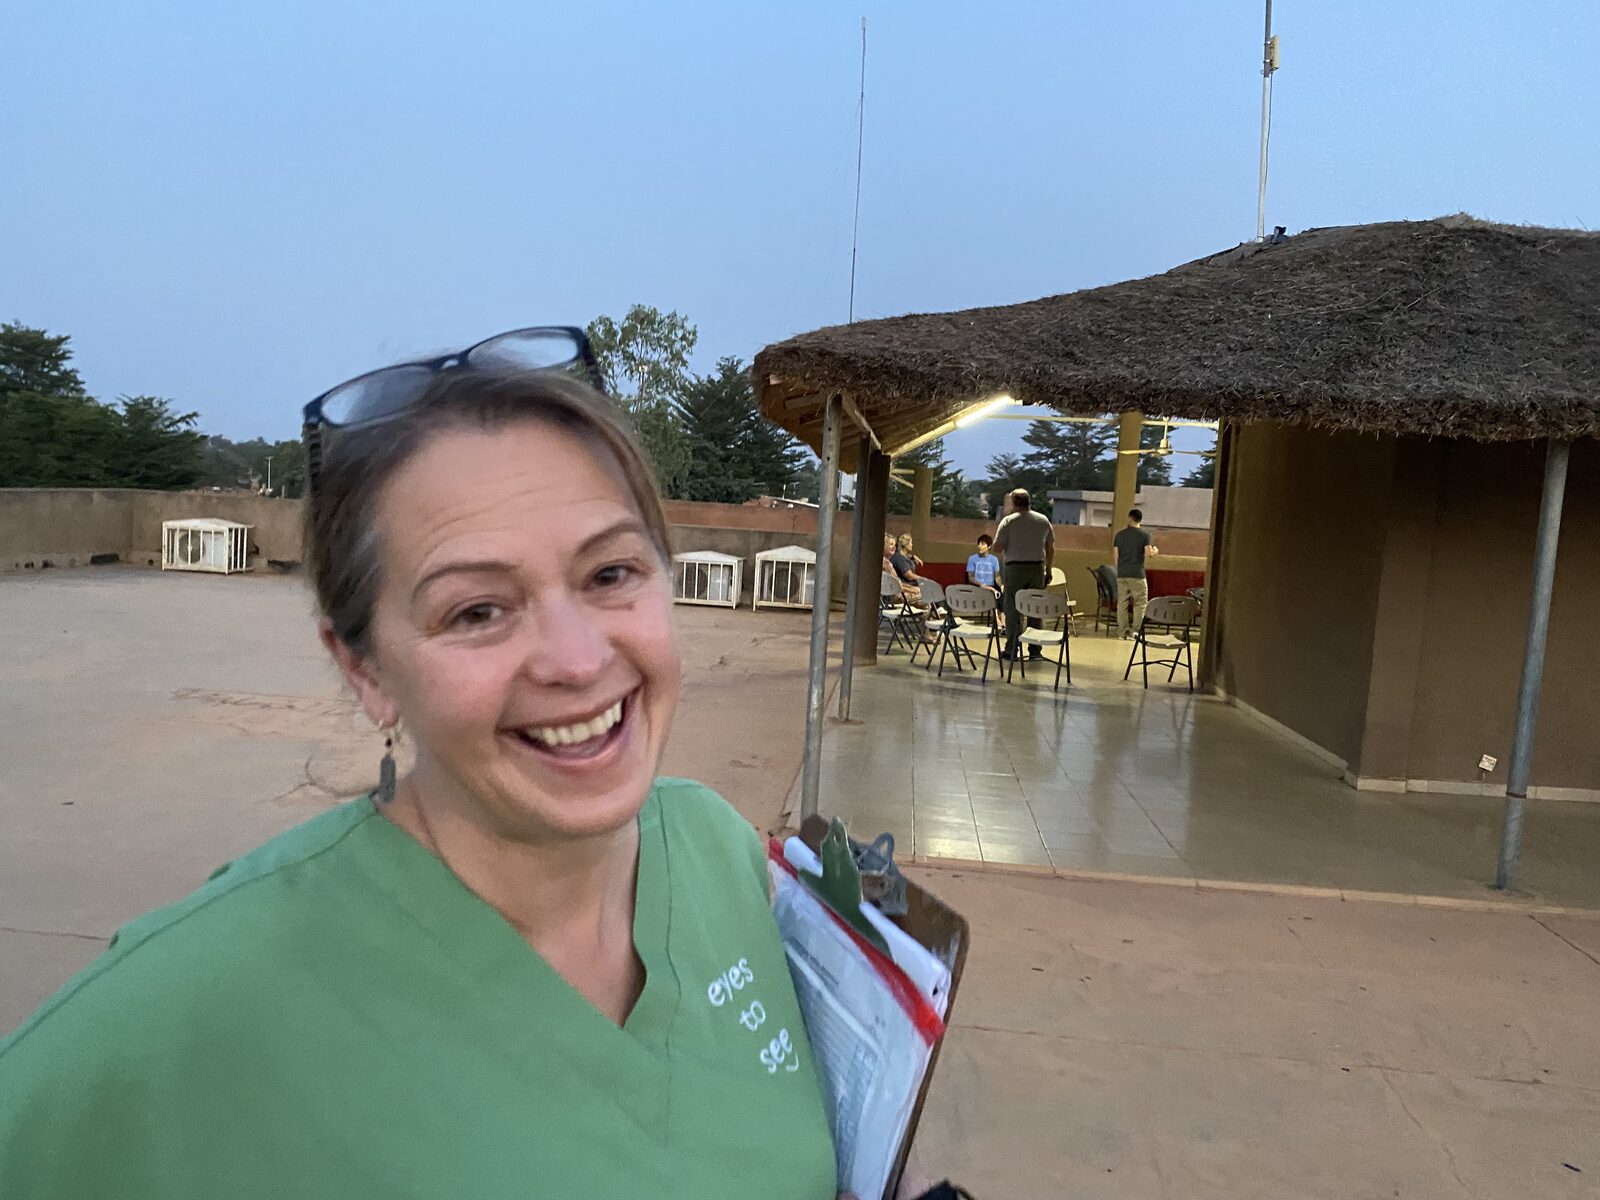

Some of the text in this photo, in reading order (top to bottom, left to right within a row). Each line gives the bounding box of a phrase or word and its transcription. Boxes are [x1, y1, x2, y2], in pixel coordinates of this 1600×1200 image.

[708, 957, 753, 1006] eyes
[739, 1000, 766, 1031] to
[760, 1028, 793, 1074] see
